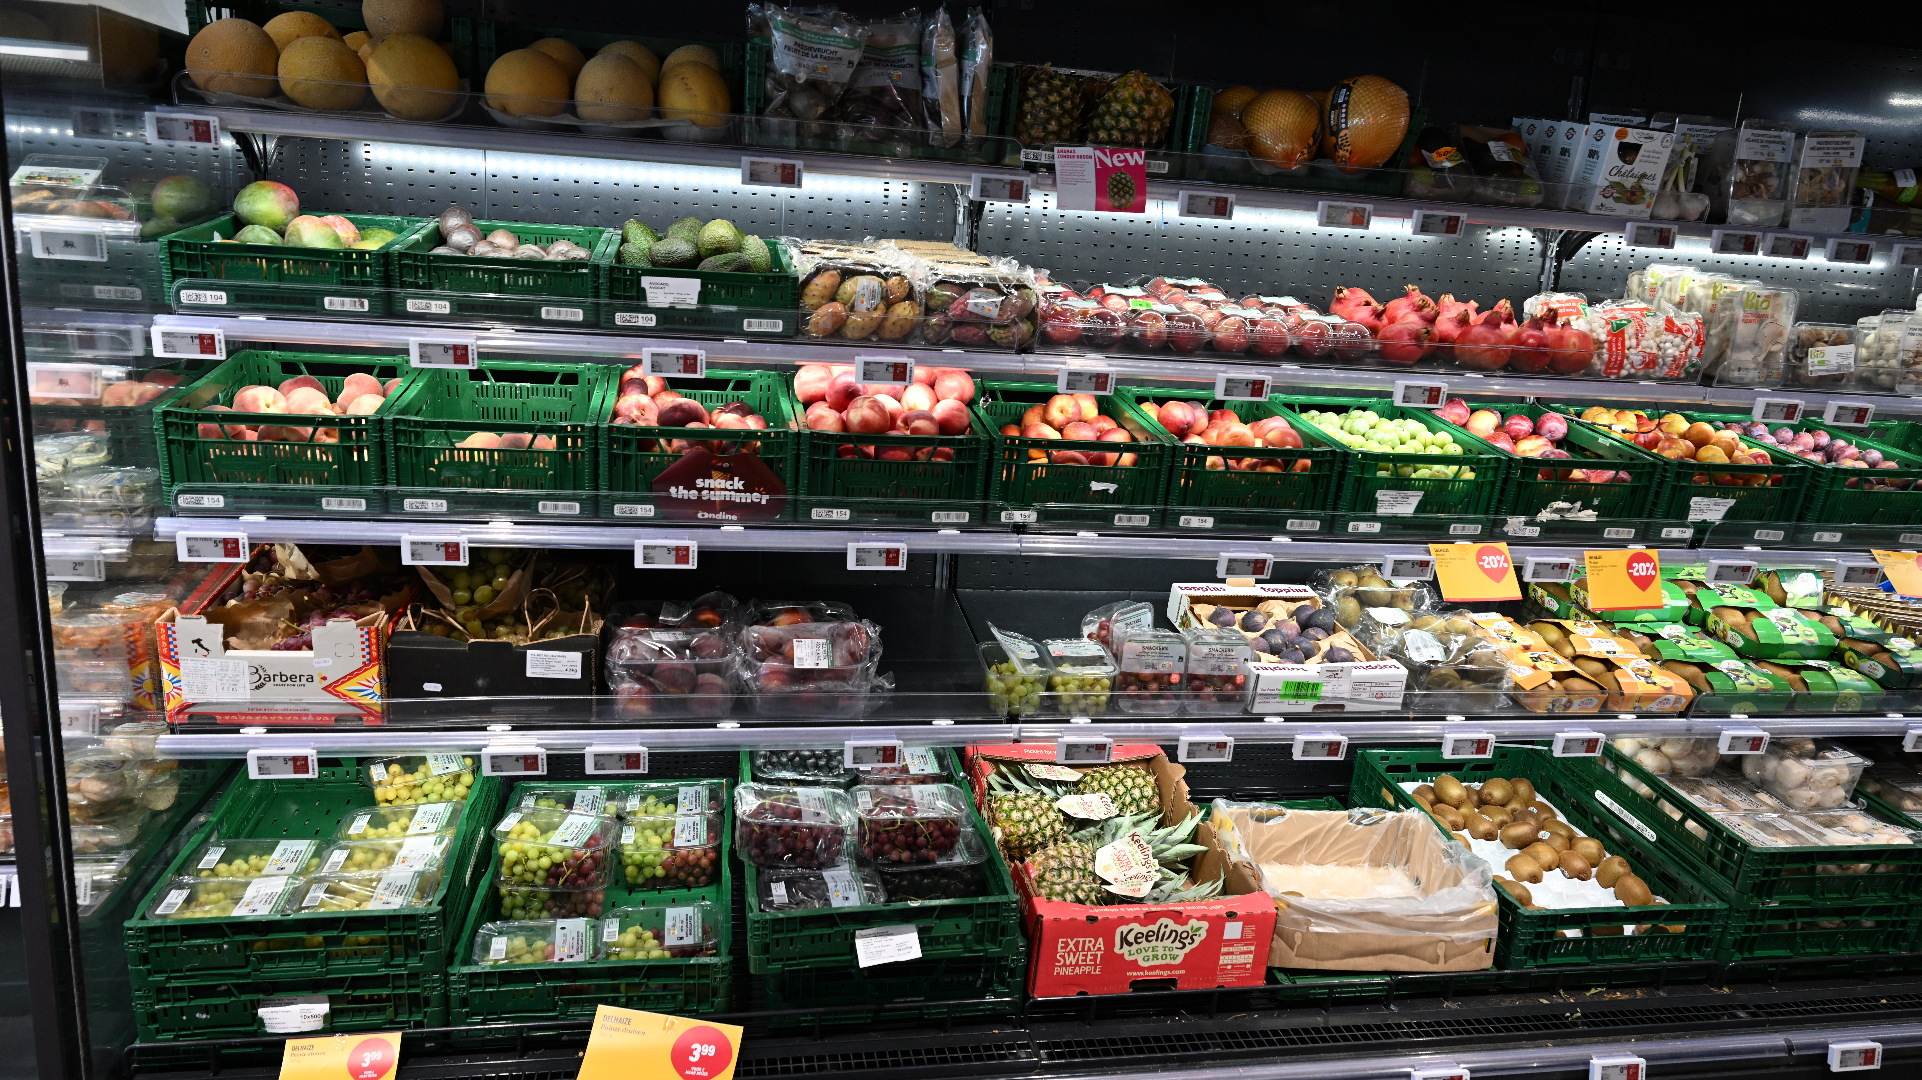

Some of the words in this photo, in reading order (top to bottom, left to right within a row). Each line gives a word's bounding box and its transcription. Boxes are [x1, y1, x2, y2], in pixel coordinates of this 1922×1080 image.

[783, 44, 801, 55] FRUIT
[820, 54, 842, 62] PASSION
[793, 41, 839, 56] PASSIEVRUCHT
[1094, 148, 1145, 169] New
[1743, 291, 1771, 311] Bio
[695, 477, 746, 490] snack
[669, 485, 709, 500] the
[711, 489, 770, 505] summer
[697, 511, 738, 521] Ondine
[1478, 555, 1509, 569] -20%
[1628, 562, 1656, 576] -20%
[1118, 922, 1199, 951] Keelings
[1057, 937, 1105, 952] EXTRA
[1127, 945, 1159, 957] LOVE
[1055, 951, 1104, 966] SWEET
[1141, 953, 1180, 963] GROW
[1054, 966, 1102, 976] PINEAPPLE
[602, 1014, 633, 1026] DELHAIZE
[361, 1050, 382, 1068] 399
[687, 1043, 716, 1063] 399
